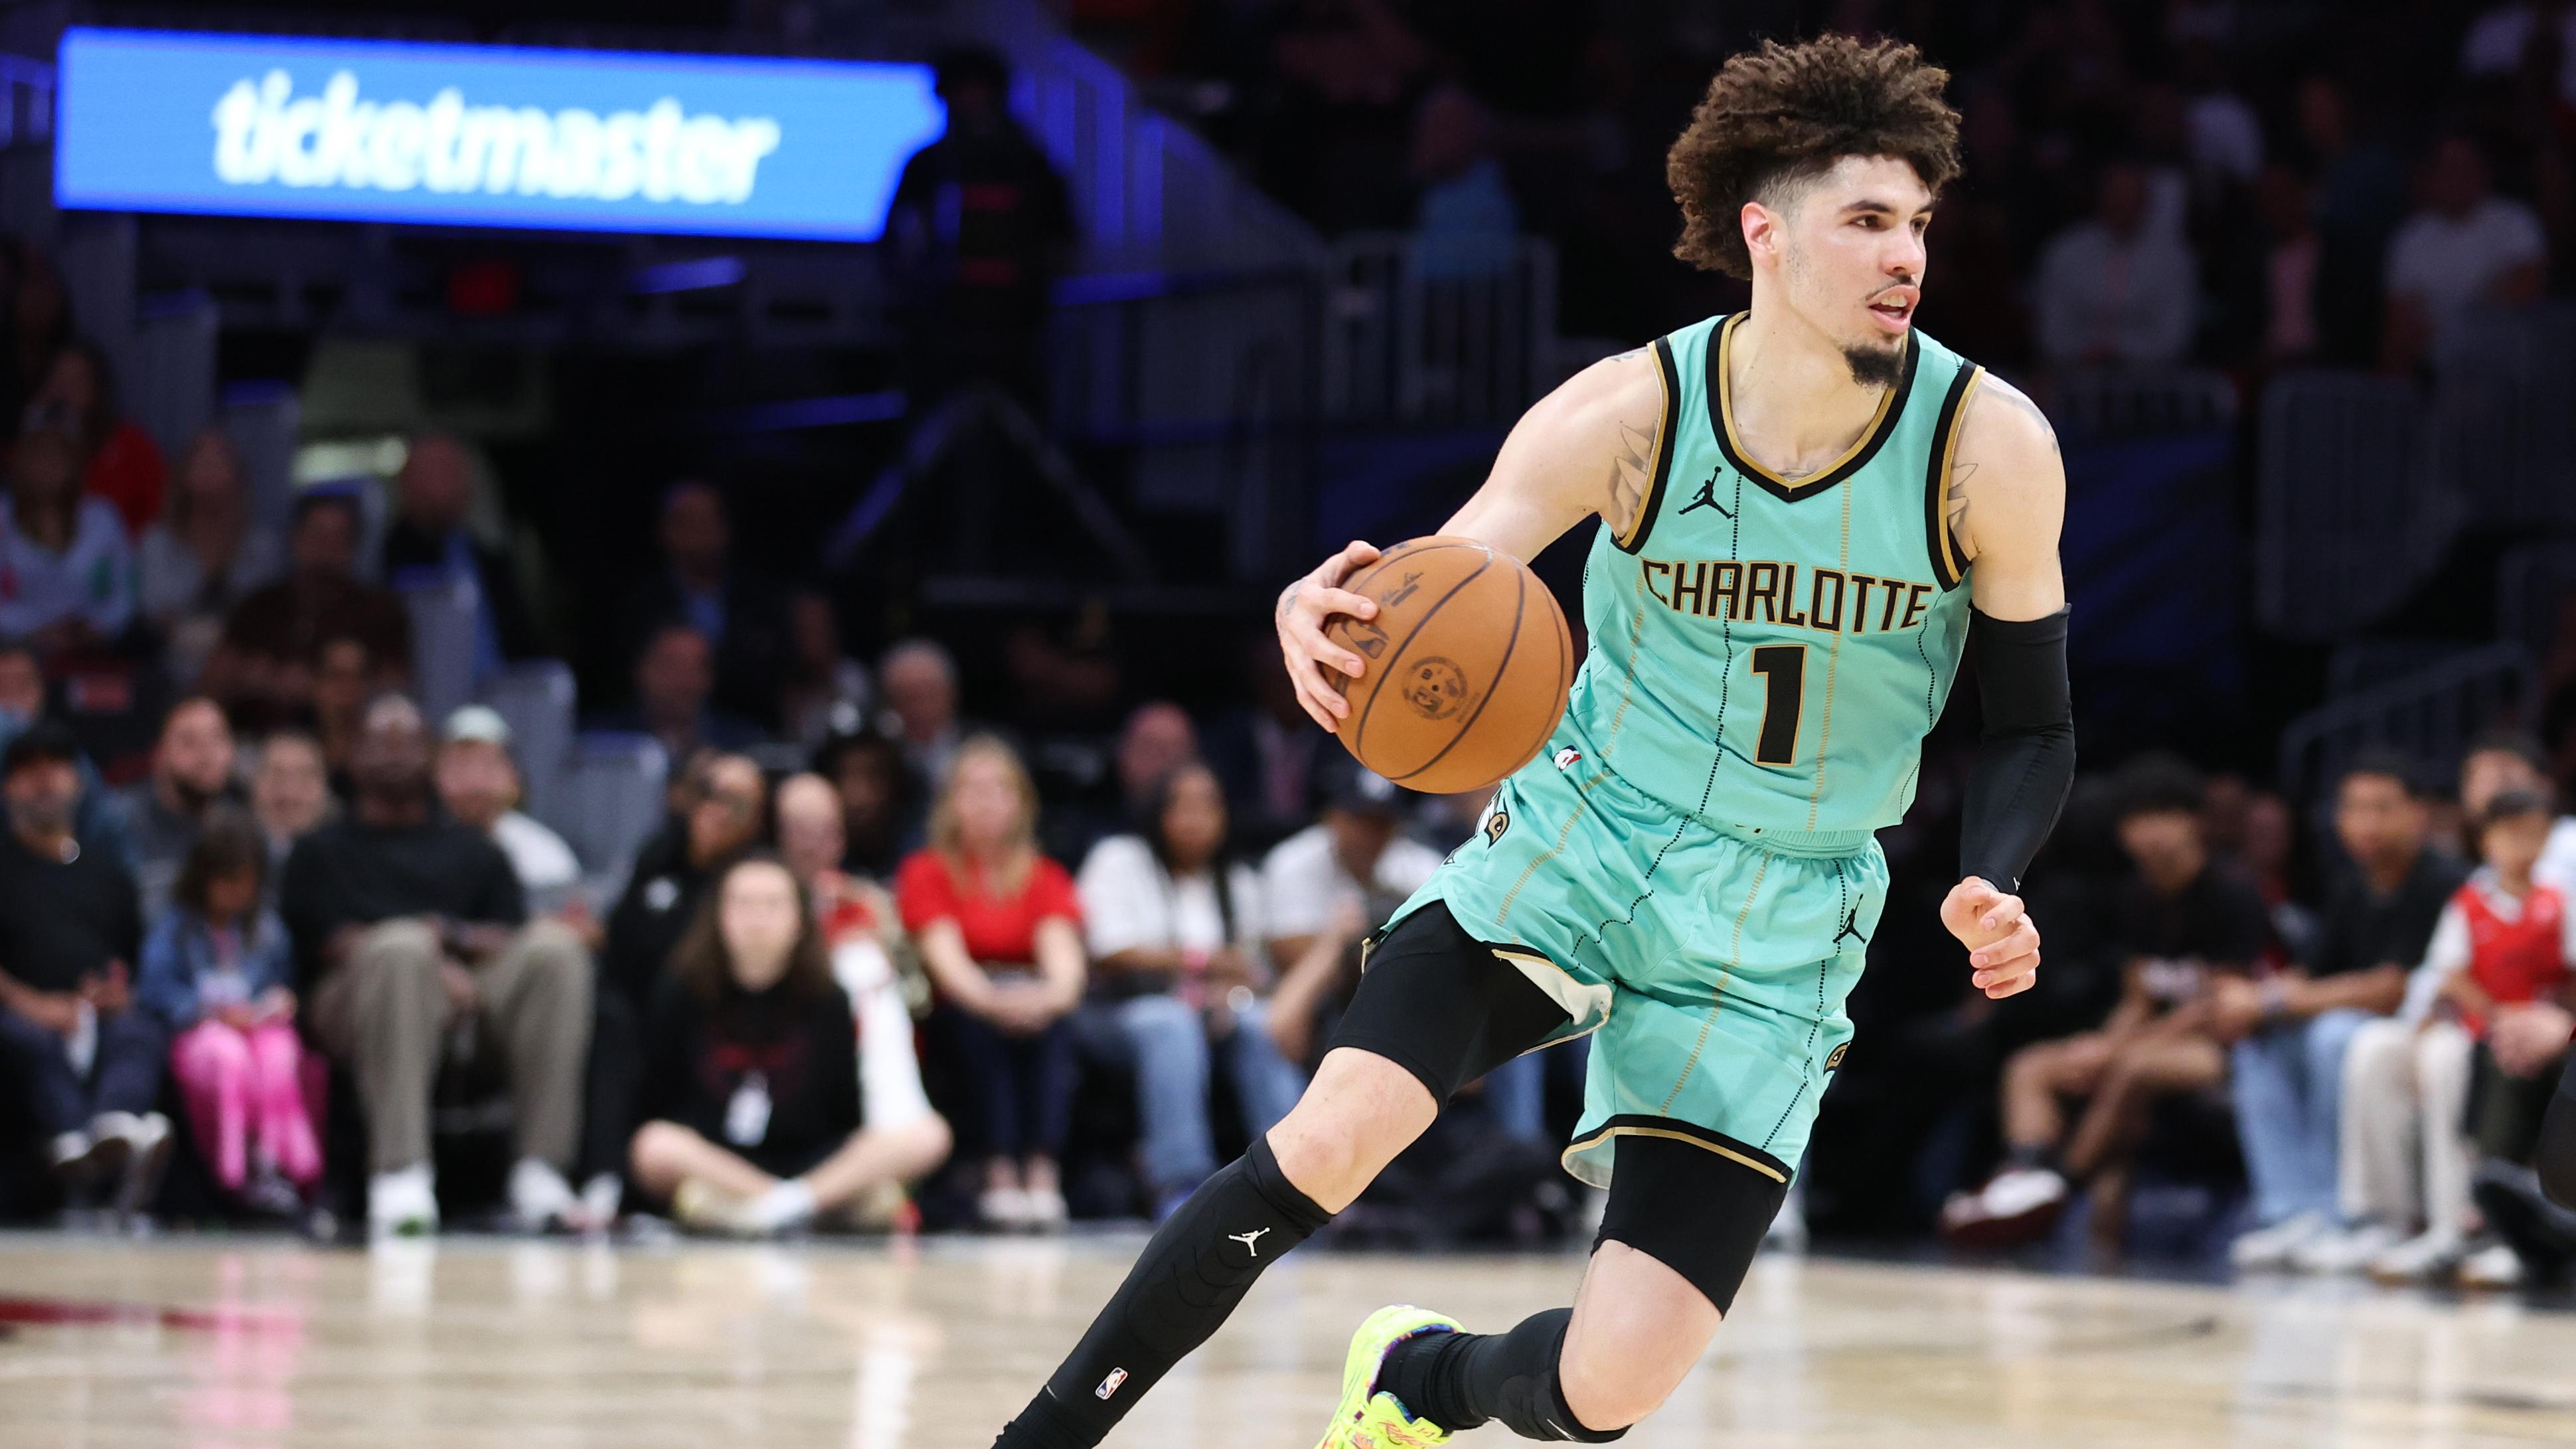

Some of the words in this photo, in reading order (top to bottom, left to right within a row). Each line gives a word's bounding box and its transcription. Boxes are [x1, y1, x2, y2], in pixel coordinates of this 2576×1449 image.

[212, 69, 781, 204] ticketmaster
[1641, 557, 1934, 634] CHARLOTTE
[1751, 645, 1808, 766] 1
